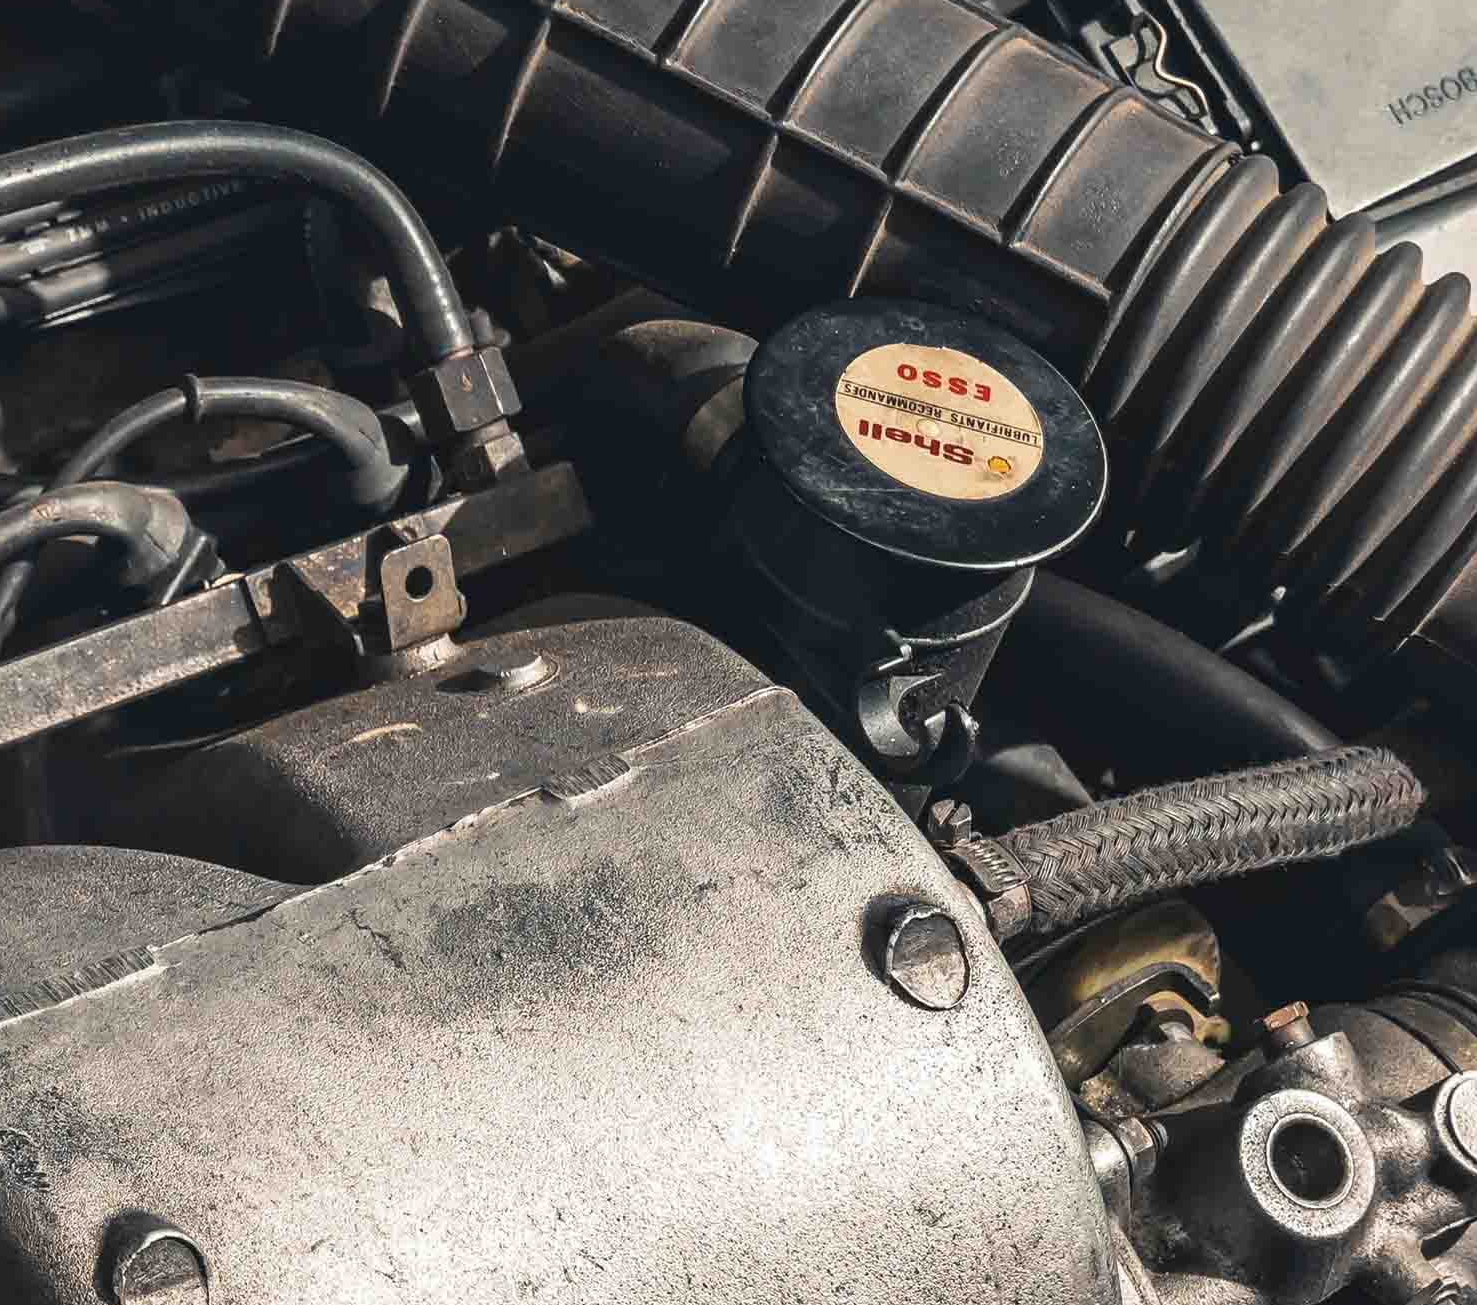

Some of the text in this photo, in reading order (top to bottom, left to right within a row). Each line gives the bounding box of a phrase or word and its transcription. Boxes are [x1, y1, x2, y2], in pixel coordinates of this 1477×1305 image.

[896, 363, 991, 403] ESSO
[843, 383, 1039, 445] LUBRIFIANTS RECOMMANDES
[858, 419, 975, 465] Shell
